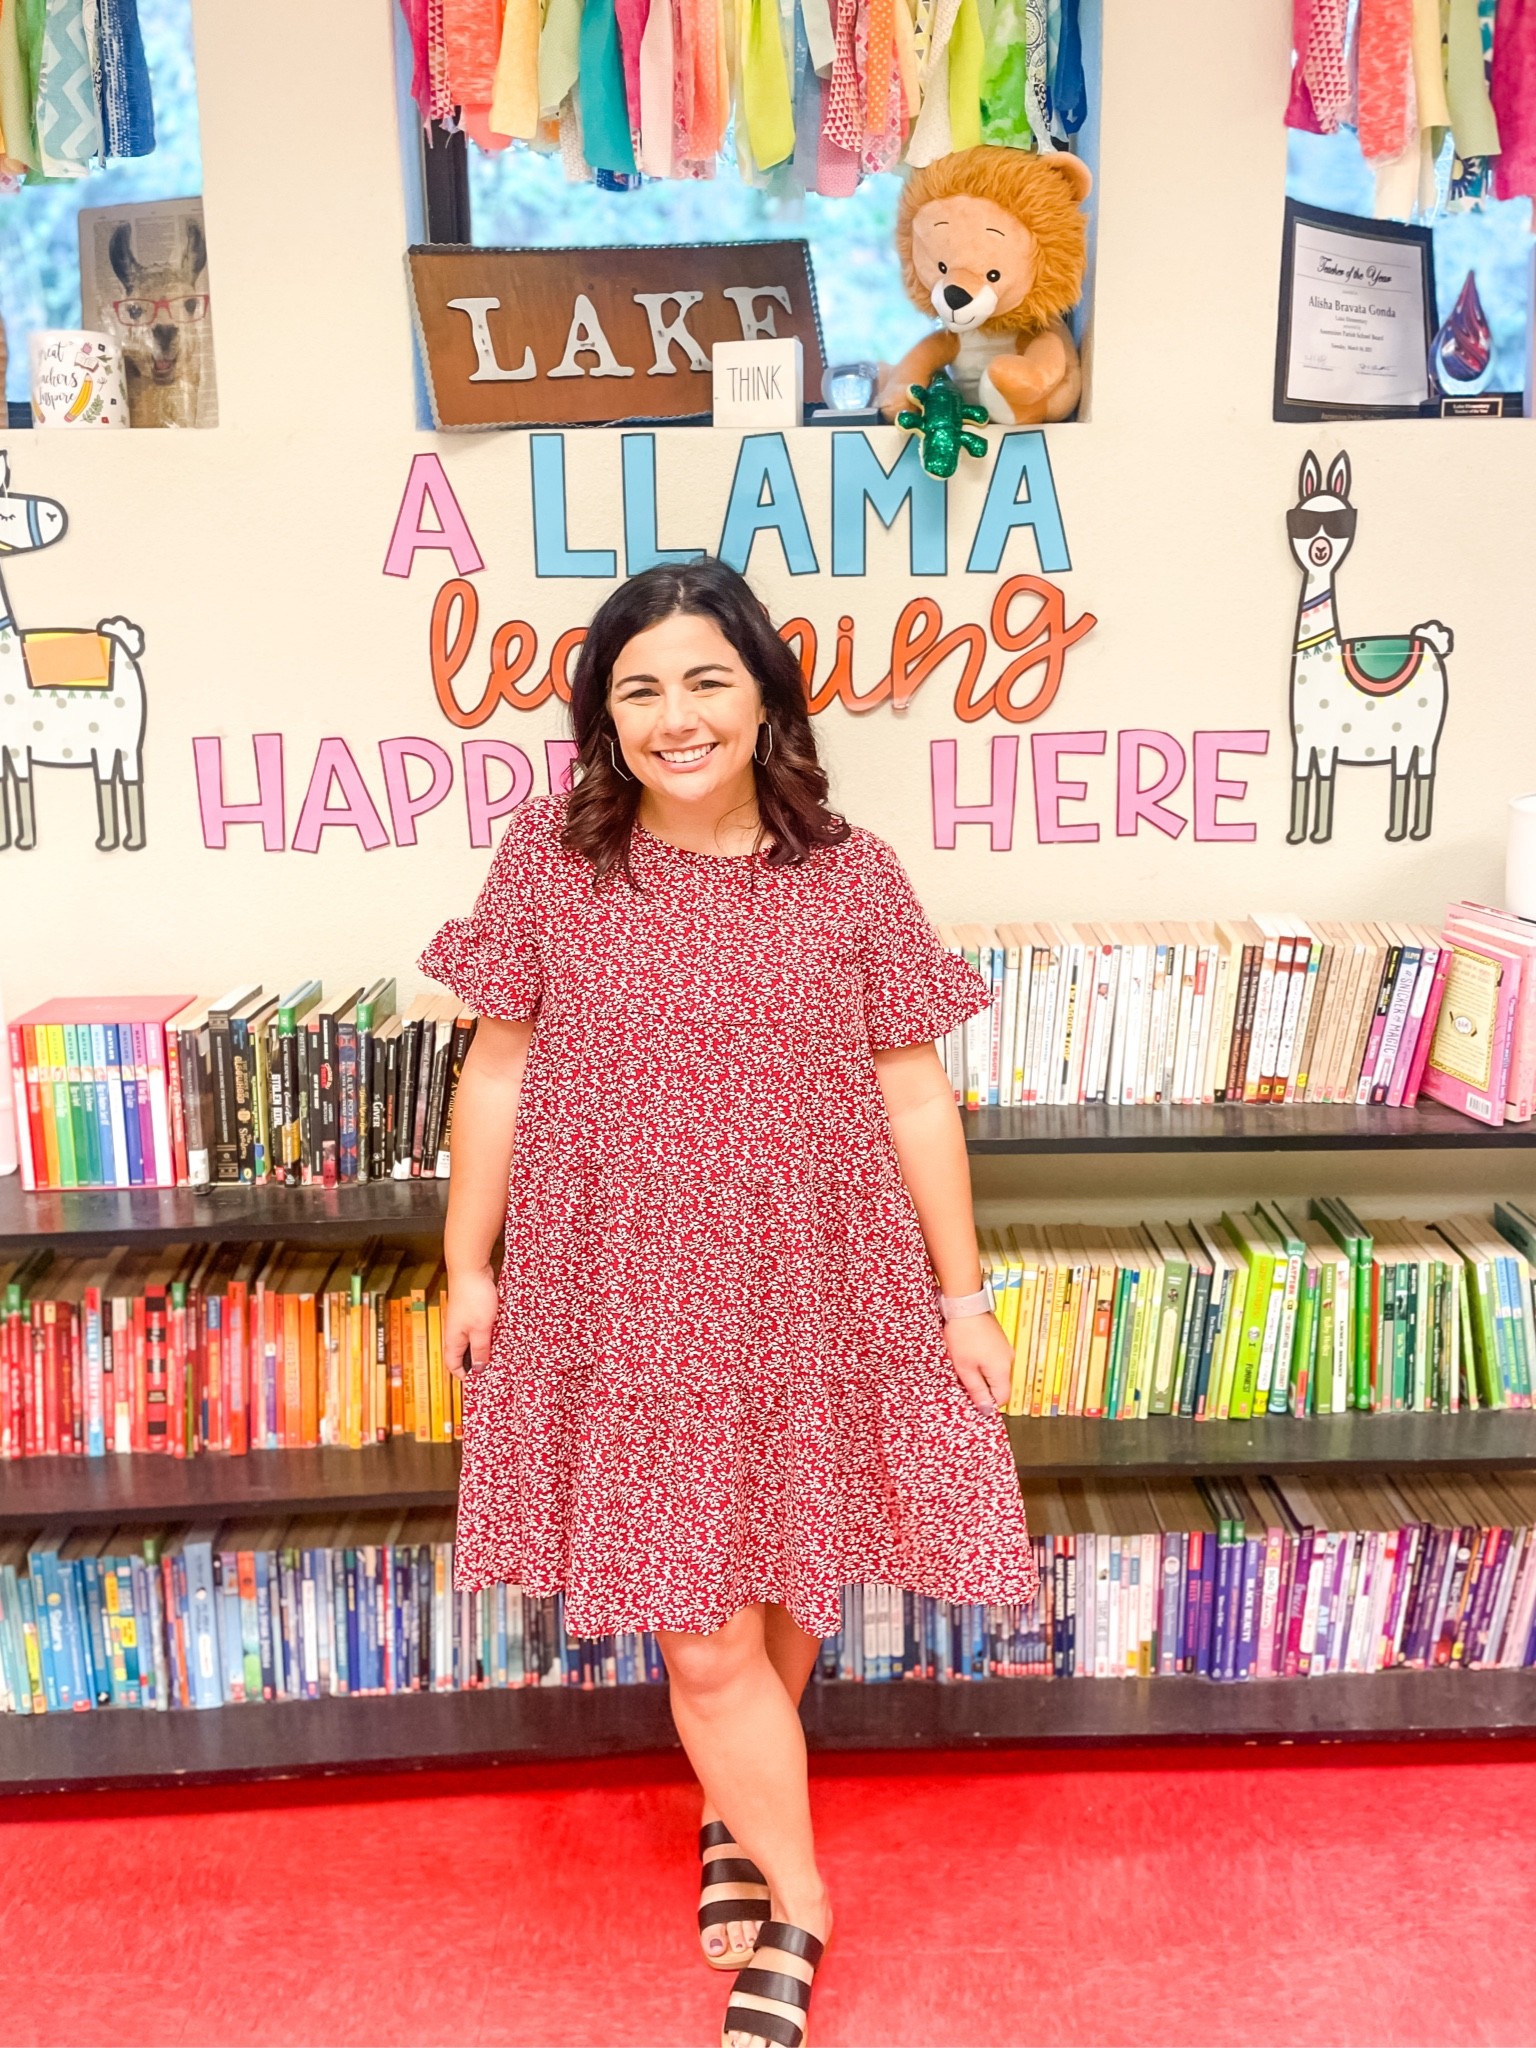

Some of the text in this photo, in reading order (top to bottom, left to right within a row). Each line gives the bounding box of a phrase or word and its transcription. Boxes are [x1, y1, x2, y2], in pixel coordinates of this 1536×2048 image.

[1317, 255, 1344, 275] Teacher
[1366, 265, 1391, 286] Year
[1309, 296, 1396, 318] Alisha Bravata Gonda
[447, 285, 797, 381] LAKE
[726, 364, 782, 402] THINK
[382, 430, 1073, 578] A LLAMA
[192, 729, 1270, 854] HAPP HERE
[1393, 978, 1413, 1014] SNICKER
[457, 1034, 465, 1058] L'ENGLE
[1383, 1024, 1399, 1054] MAGIC
[373, 1101, 383, 1128] GIVER
[239, 1128, 247, 1159] Shadows
[1041, 1313, 1049, 1339] handful
[1282, 1322, 1291, 1349] CREATURE
[1323, 1316, 1332, 1334] Ruby
[1242, 1363, 1254, 1393] FUNNIEST
[1067, 1560, 1076, 1596] BUFFALO
[1244, 1578, 1255, 1608] BLACK
[1241, 1608, 1253, 1643] BEAUTY
[1318, 1605, 1330, 1635] ARF
